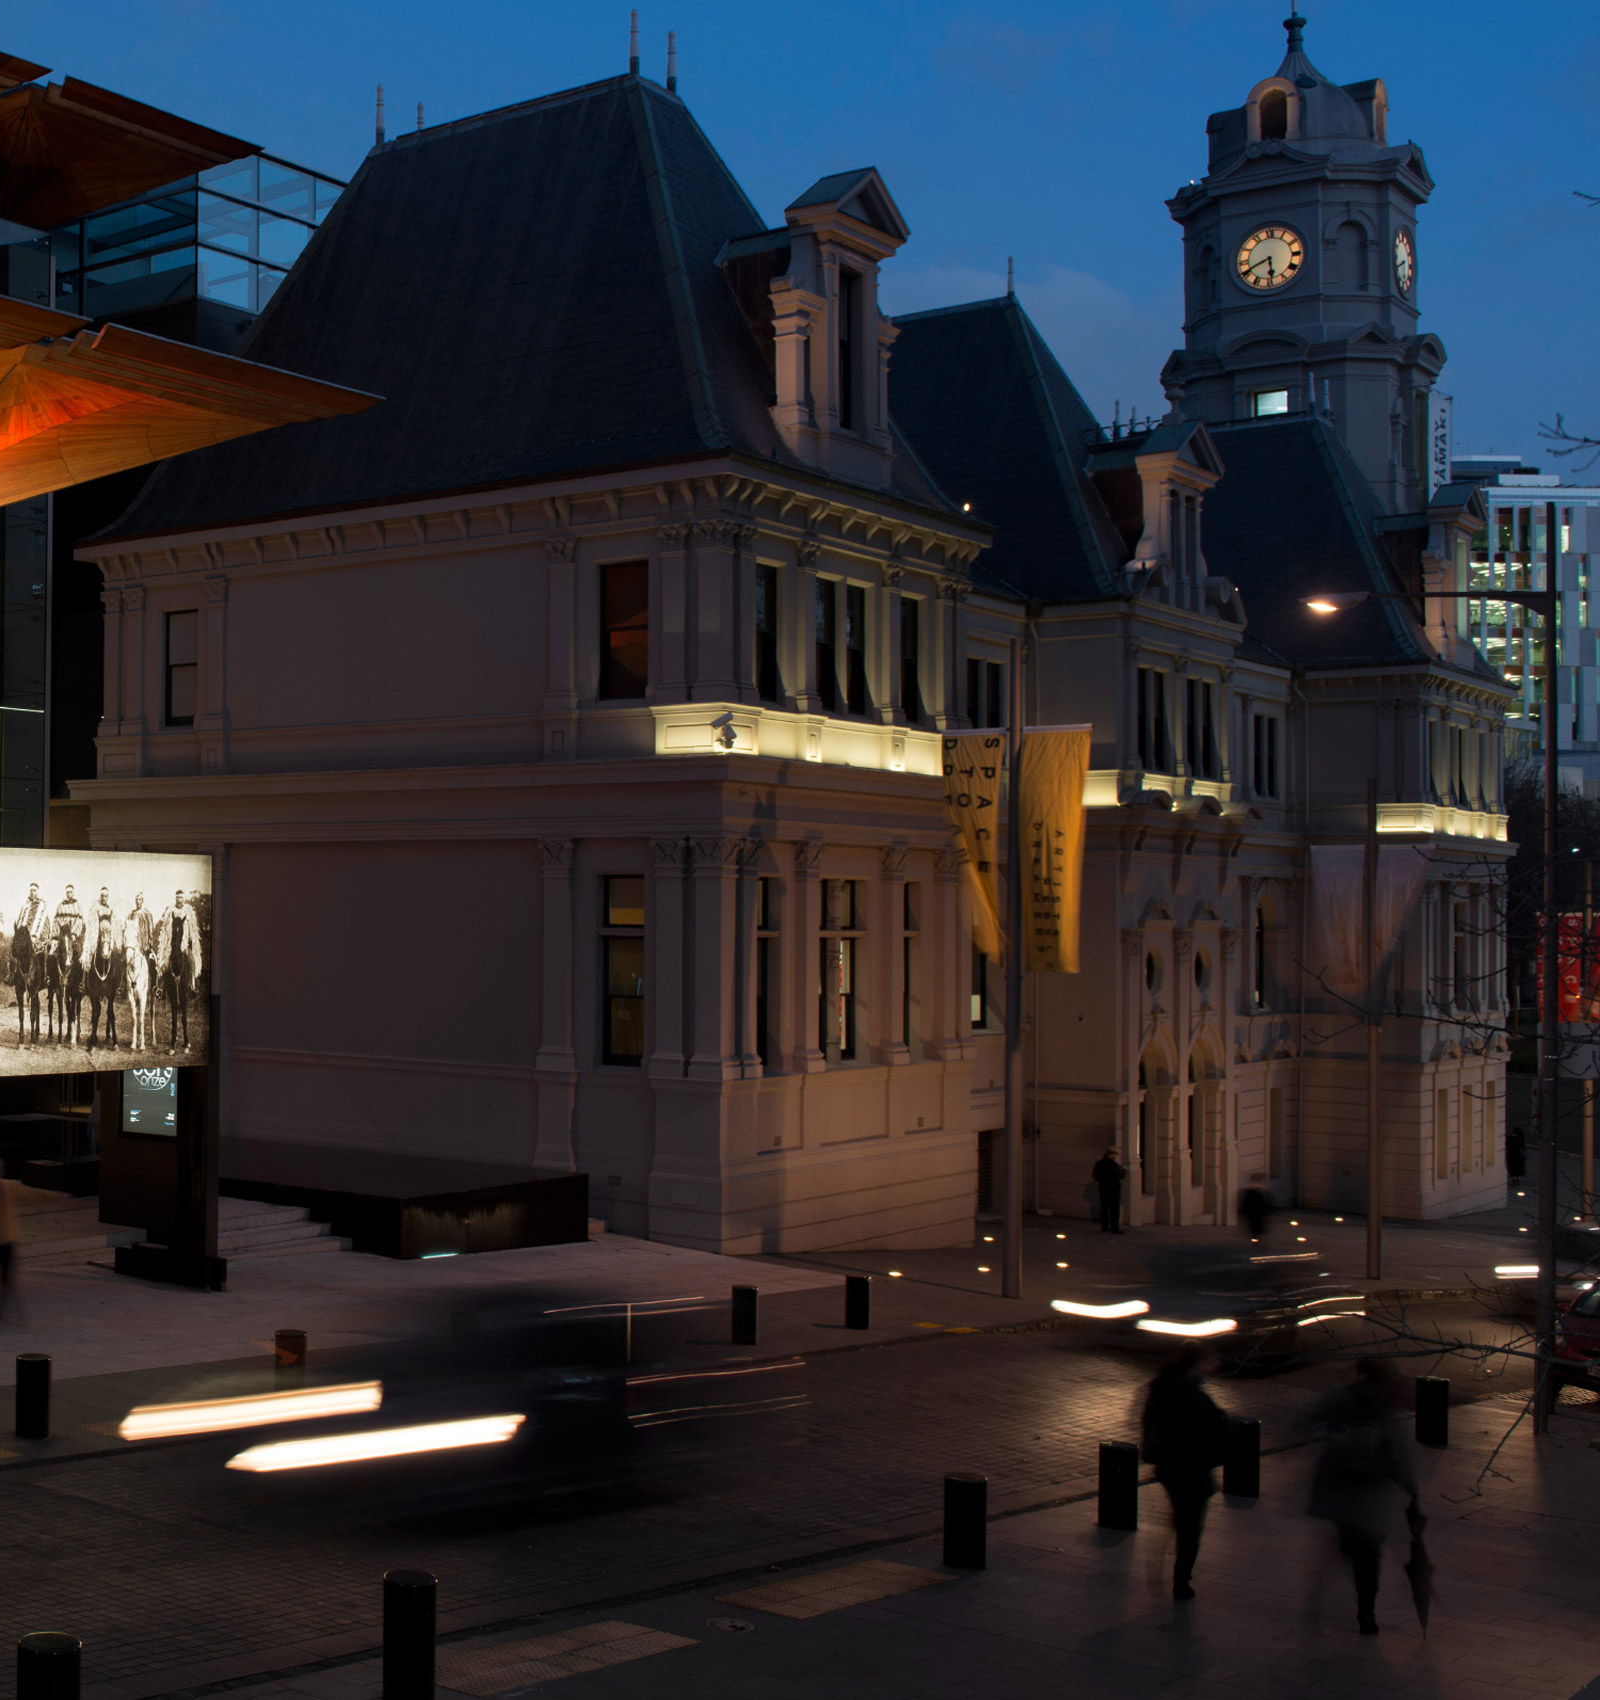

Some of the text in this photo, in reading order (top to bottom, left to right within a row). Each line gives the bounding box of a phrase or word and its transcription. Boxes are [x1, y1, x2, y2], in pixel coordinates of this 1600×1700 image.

[957, 766, 974, 807] TO
[976, 738, 999, 873] SPACE
[1051, 830, 1062, 936] ARTISTS
